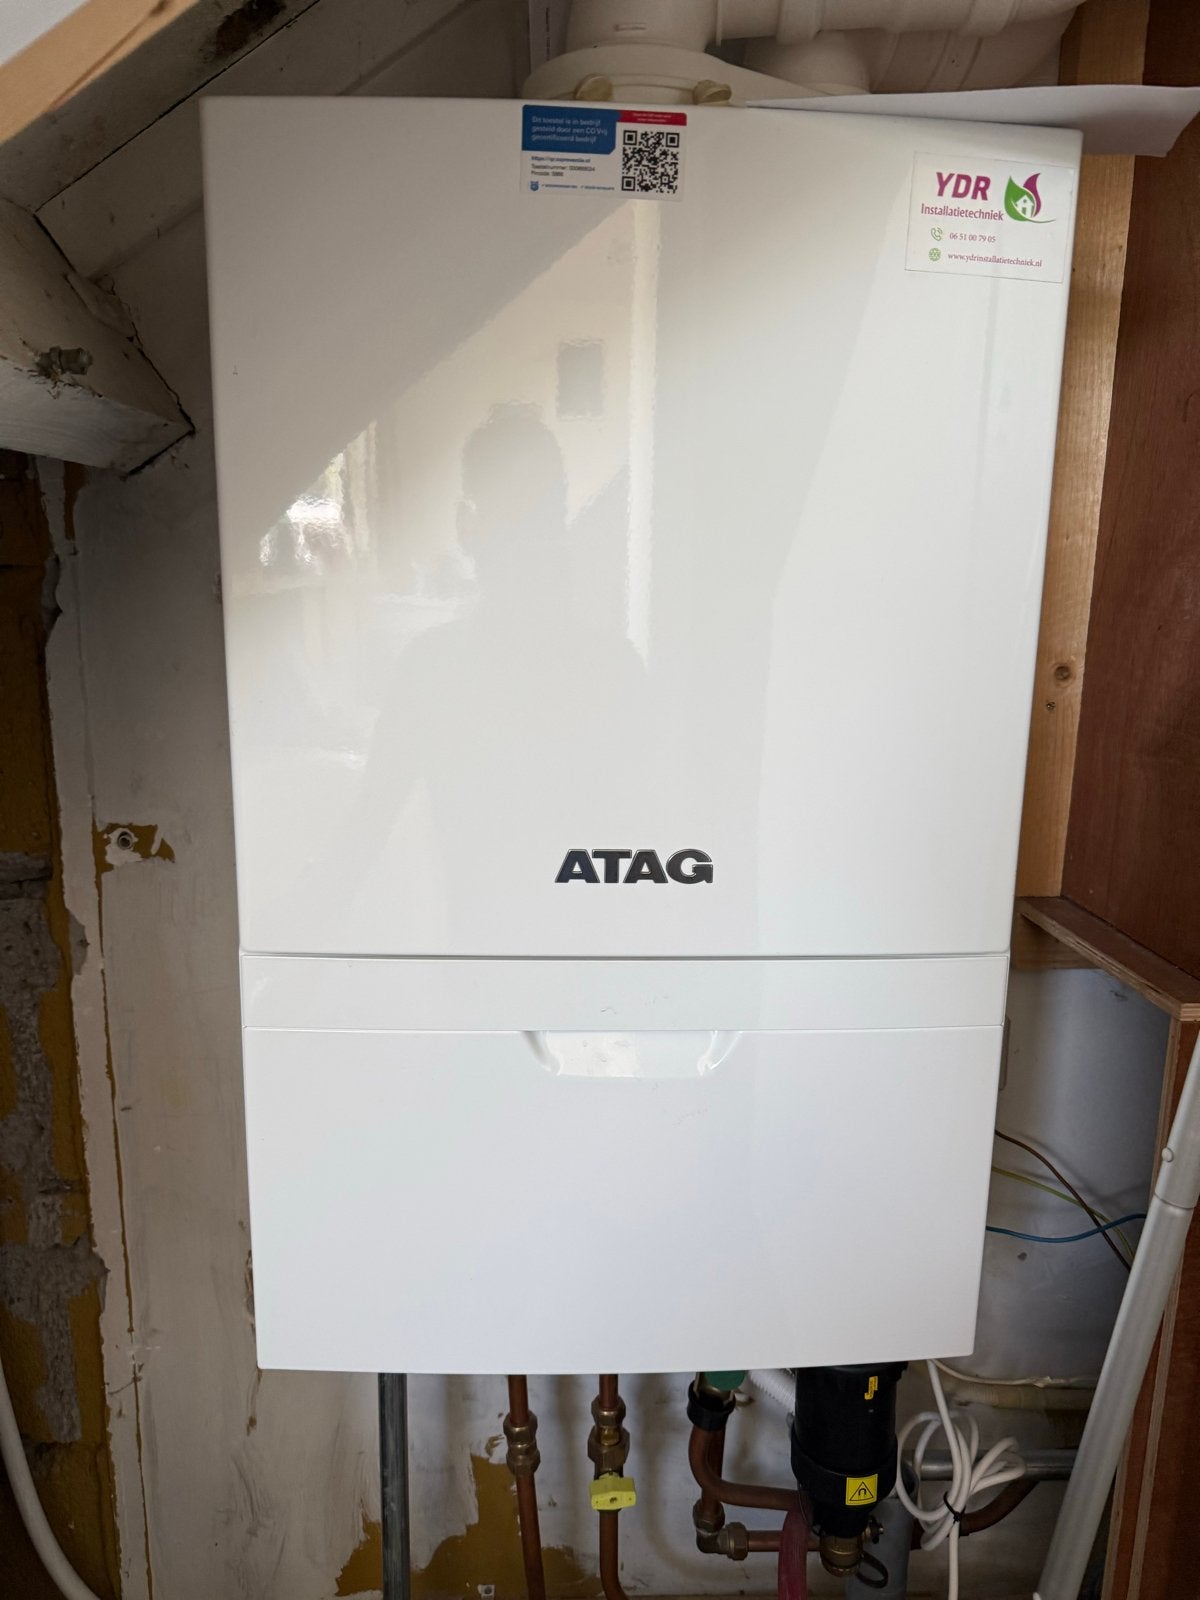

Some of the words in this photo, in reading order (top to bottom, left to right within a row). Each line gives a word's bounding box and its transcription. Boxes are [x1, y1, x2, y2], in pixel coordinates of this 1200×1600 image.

[532, 125, 555, 133] gesteld
[580, 119, 601, 127] bedrijf
[575, 135, 596, 145] bedrijf
[936, 171, 991, 201] YDR
[921, 203, 1004, 222] Installatietechniek
[949, 232, 958, 240] 06
[958, 233, 967, 241] 51
[968, 234, 977, 242] 00
[978, 234, 987, 243] 79
[987, 235, 996, 243] 05
[947, 252, 1042, 268] www.ydrinstallatietechniek.nl
[554, 848, 714, 885] ATAG
